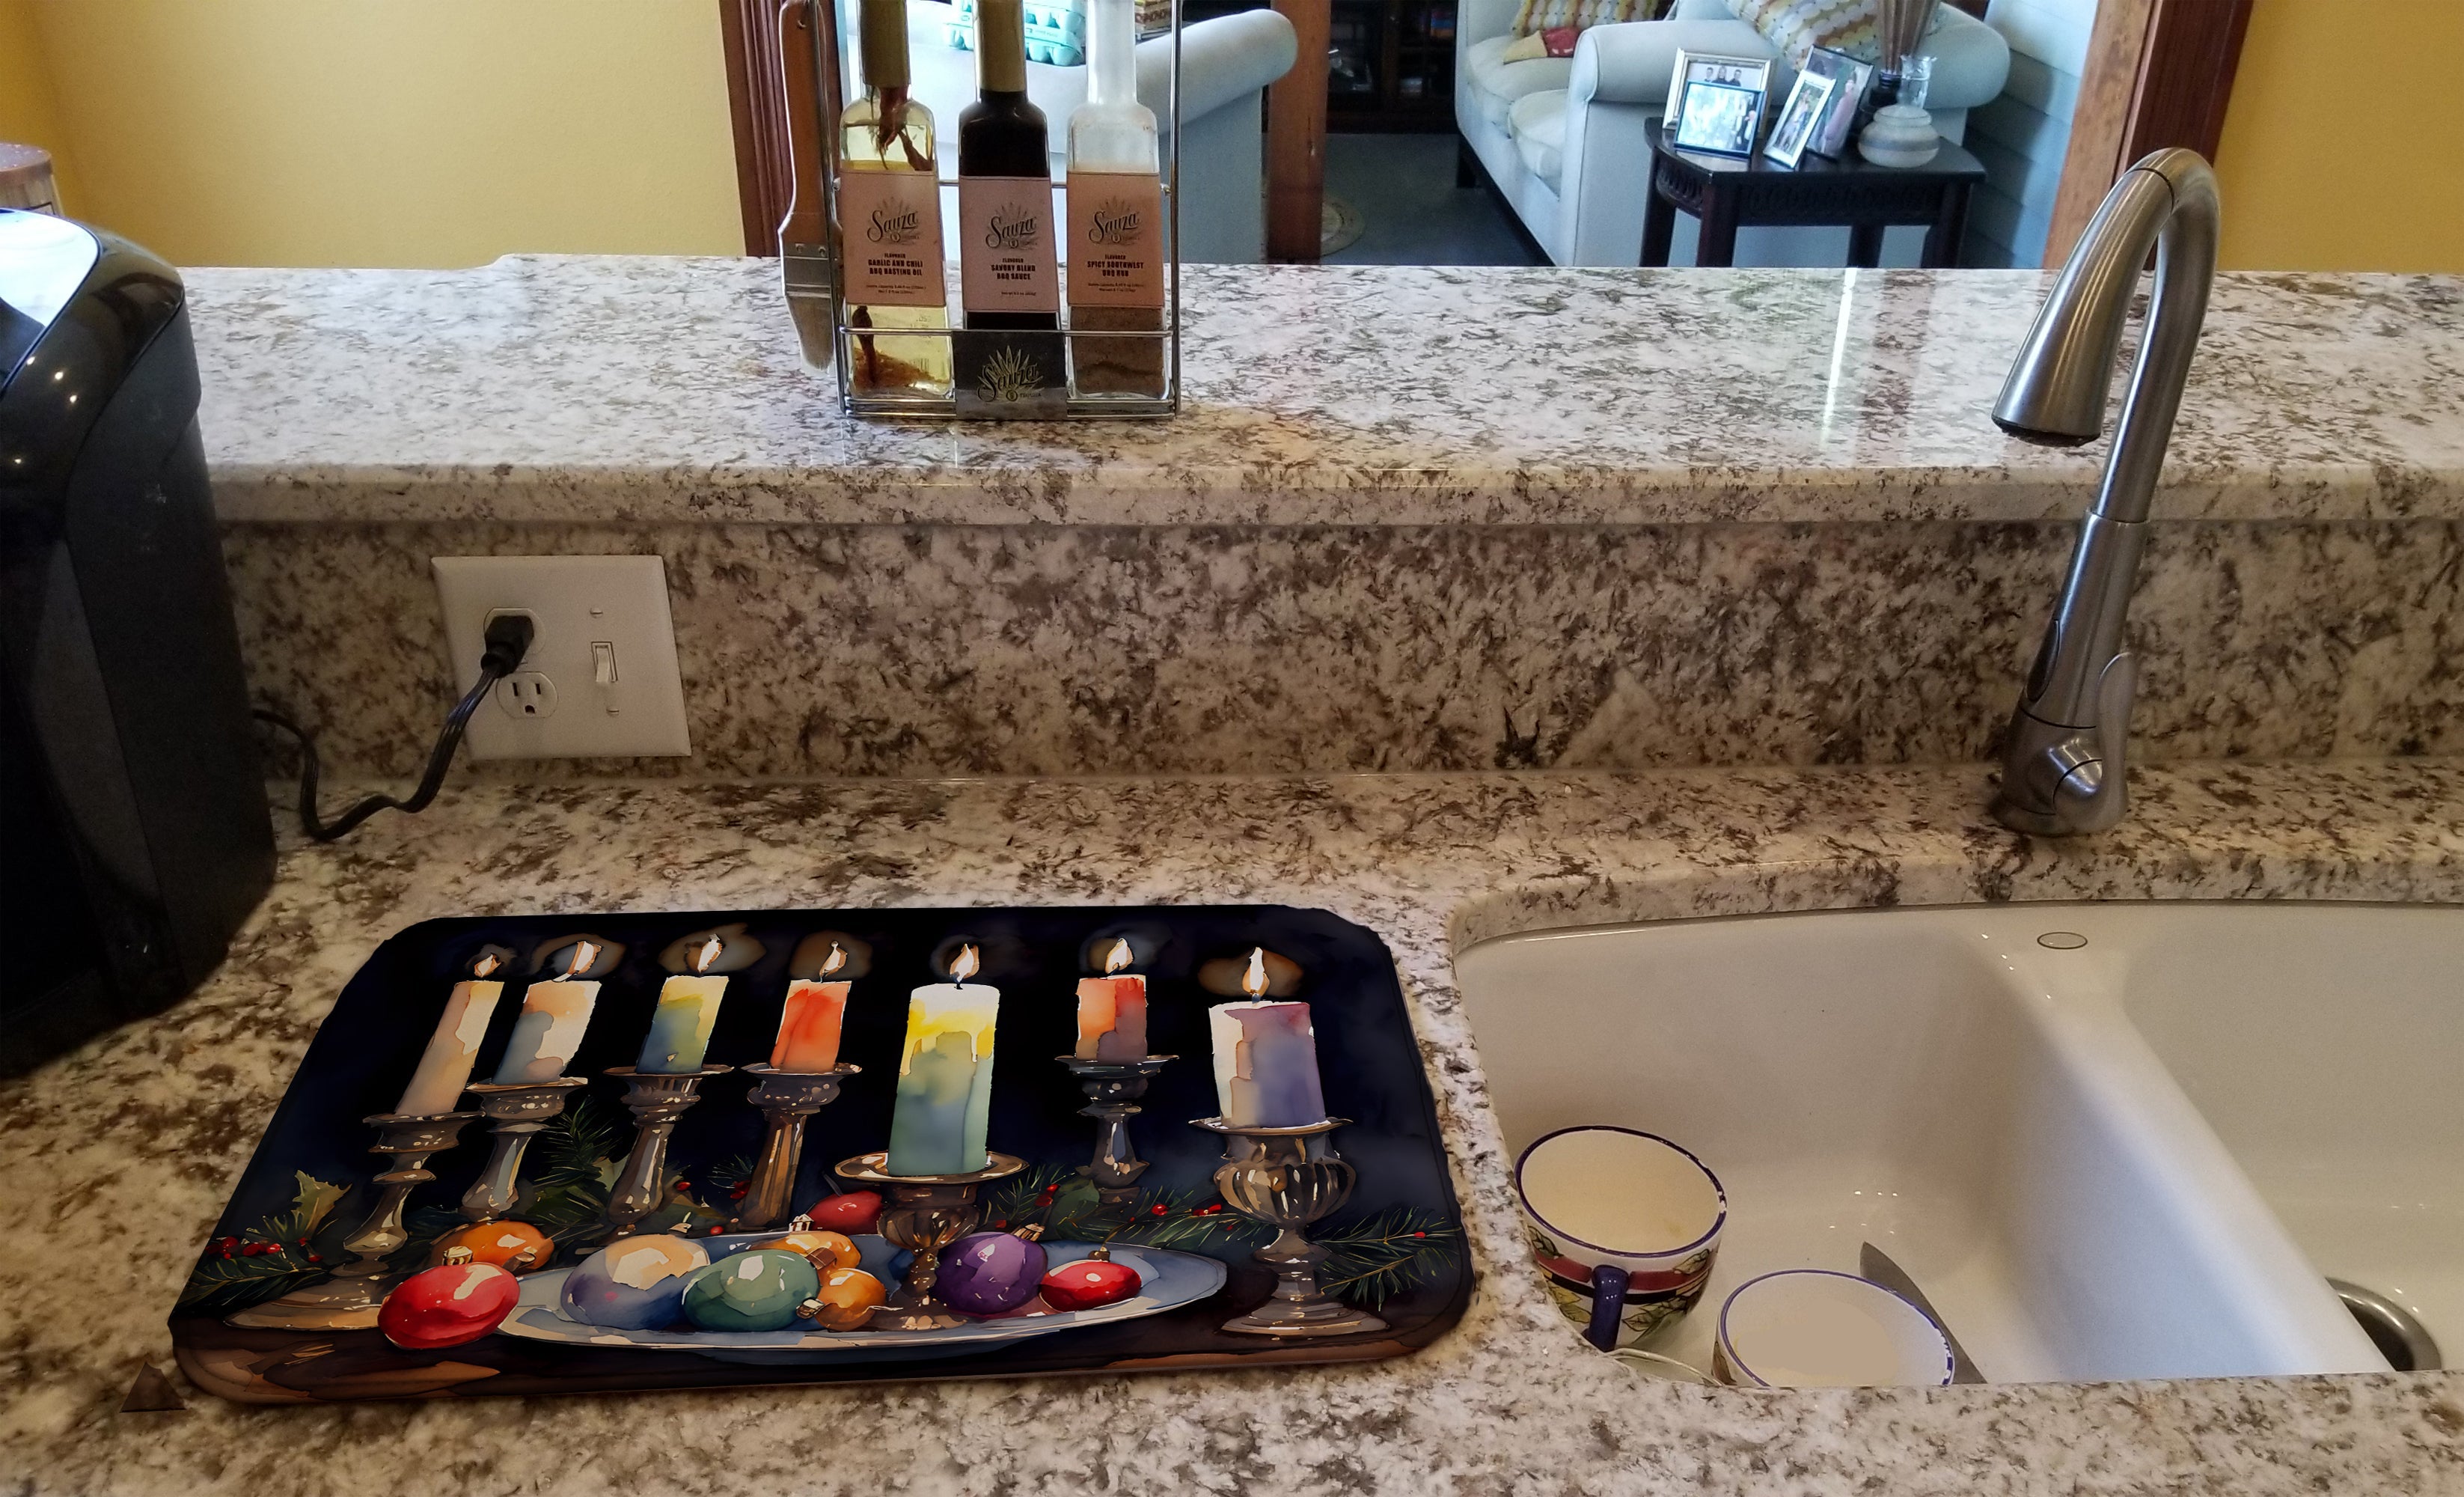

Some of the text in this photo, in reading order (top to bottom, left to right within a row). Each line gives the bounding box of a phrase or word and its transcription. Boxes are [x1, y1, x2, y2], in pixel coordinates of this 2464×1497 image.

[867, 210, 918, 242] Sauza
[985, 216, 1036, 249] Sauza
[1089, 211, 1138, 243] Sauza
[977, 363, 1043, 402] Sauza
